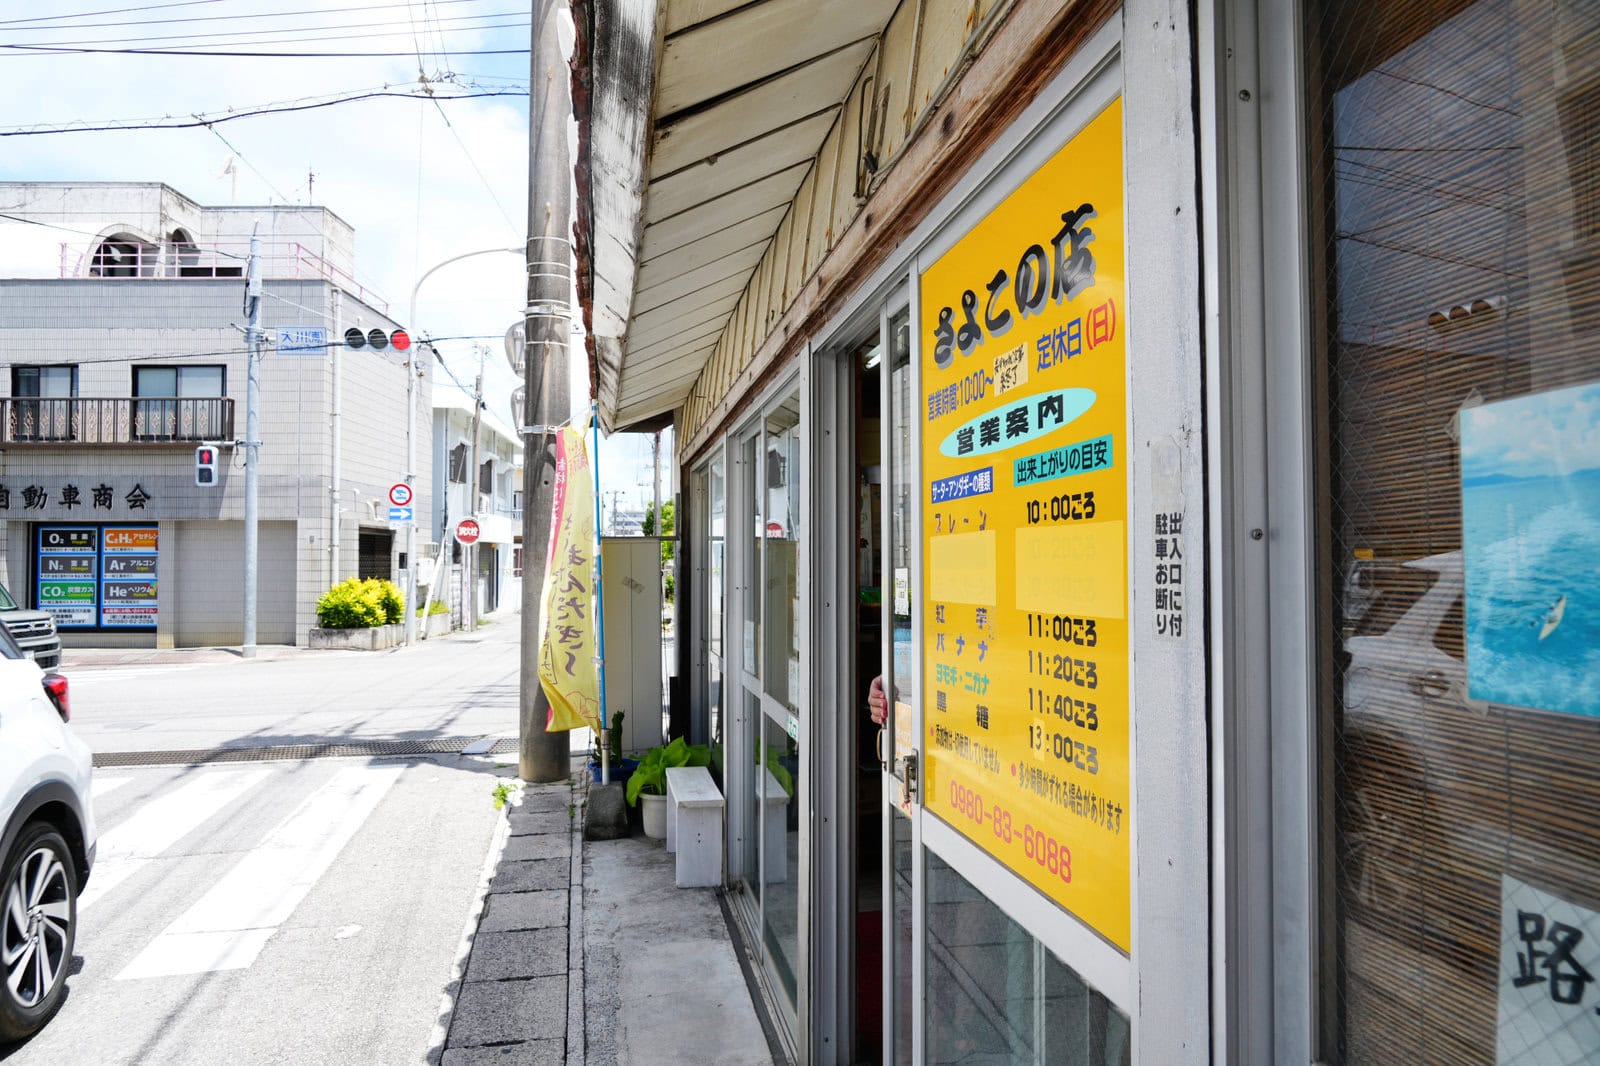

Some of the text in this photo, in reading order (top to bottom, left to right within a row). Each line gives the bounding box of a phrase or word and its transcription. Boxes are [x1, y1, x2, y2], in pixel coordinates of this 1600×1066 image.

[956, 394, 1064, 456] 営業案内
[1017, 440, 1107, 483] 出来上がりの目安
[1027, 491, 1095, 524] 10:00ごろ
[109, 560, 126, 571] Ar
[1155, 513, 1168, 635] 駐車お断り
[1169, 512, 1182, 637] 出入口に付
[109, 586, 127, 597] He
[936, 633, 988, 662] バナナ
[1027, 613, 1097, 647] 11:00ごろ
[1028, 650, 1098, 690] 11:20ごろ
[936, 690, 989, 730] 黒糖
[1028, 687, 1098, 731] 11:40ごろ
[1029, 725, 1099, 775] 13:00ごろ
[950, 780, 1072, 884] 0980-83-6088
[1512, 909, 1595, 1005] 路
